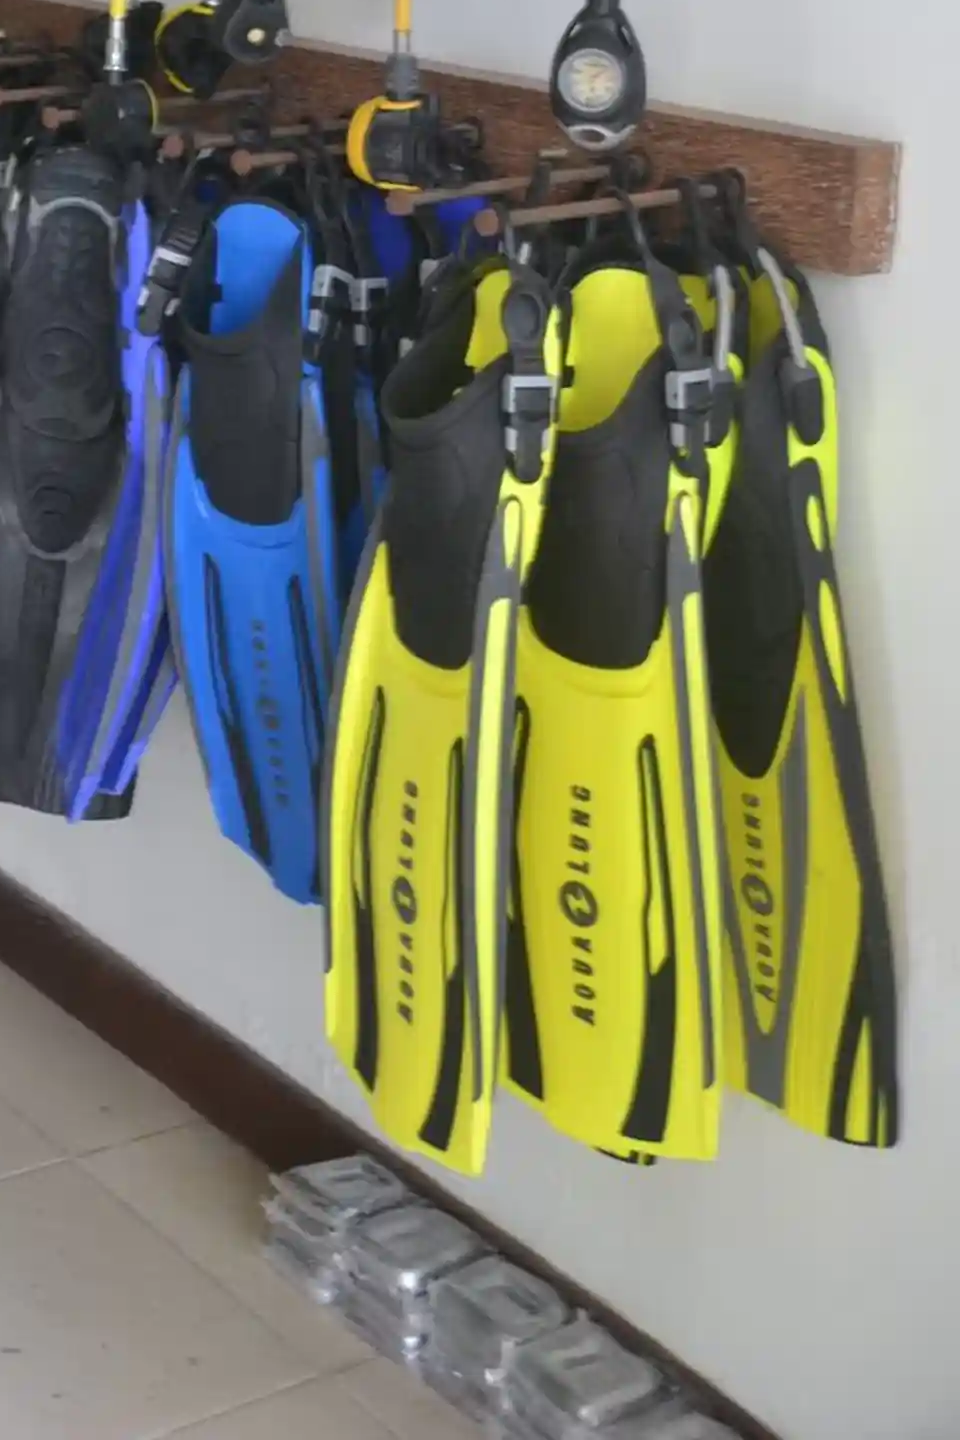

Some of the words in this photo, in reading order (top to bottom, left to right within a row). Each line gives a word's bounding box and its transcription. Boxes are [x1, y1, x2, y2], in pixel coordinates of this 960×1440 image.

[396, 779, 419, 871] LUNG
[566, 784, 591, 875] LUNG
[741, 791, 763, 870] LUNG
[395, 931, 415, 1026] AQUA
[571, 936, 597, 1026] AQUA
[754, 922, 777, 1003] AQUA
